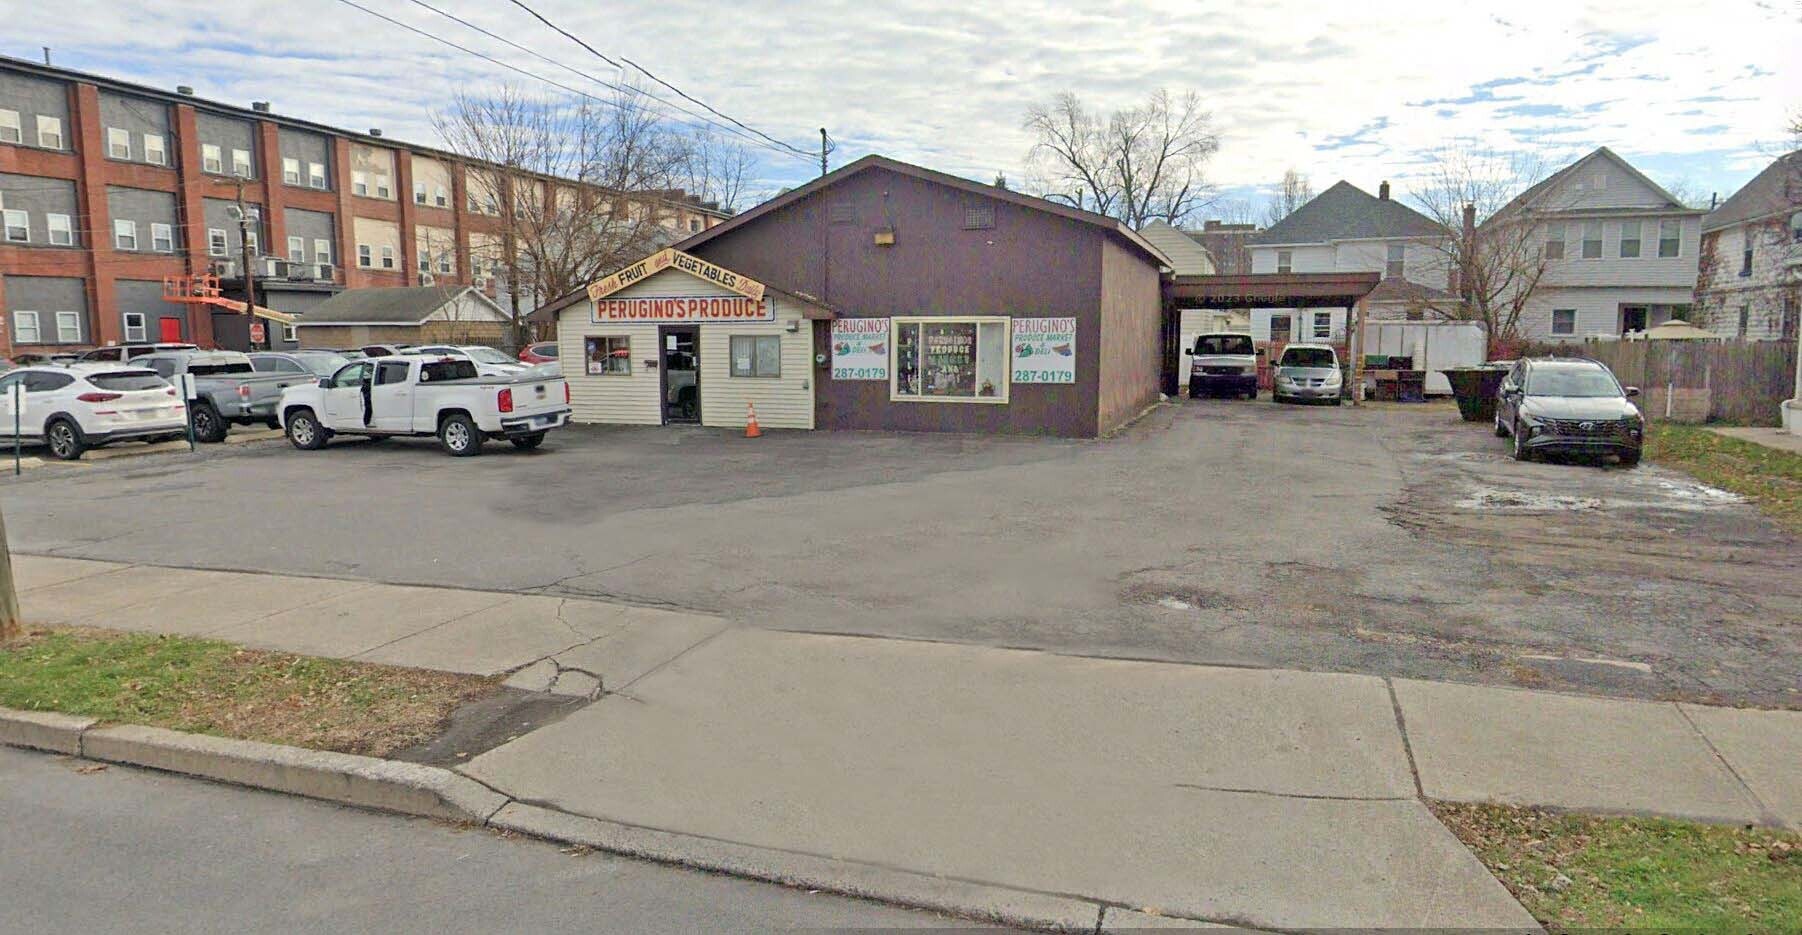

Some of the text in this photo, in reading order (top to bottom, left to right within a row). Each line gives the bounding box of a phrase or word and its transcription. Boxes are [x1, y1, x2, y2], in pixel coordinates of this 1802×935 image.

[591, 278, 618, 298] Fresh
[618, 262, 648, 286] FRUIT
[672, 252, 737, 288] VEGETABLES
[738, 278, 761, 299] Daily
[598, 299, 767, 318] PERUGINO'S PRODUCE
[831, 319, 889, 333] PERUGINO'S
[1013, 319, 1075, 334] PERUGINO'S
[834, 333, 886, 341] PRODUCE MARKET
[1015, 333, 1073, 342] PRODUCE MARKET
[930, 345, 970, 354] PRODUCE
[834, 367, 886, 379] 287-0179
[1015, 369, 1072, 382] 287-0179
